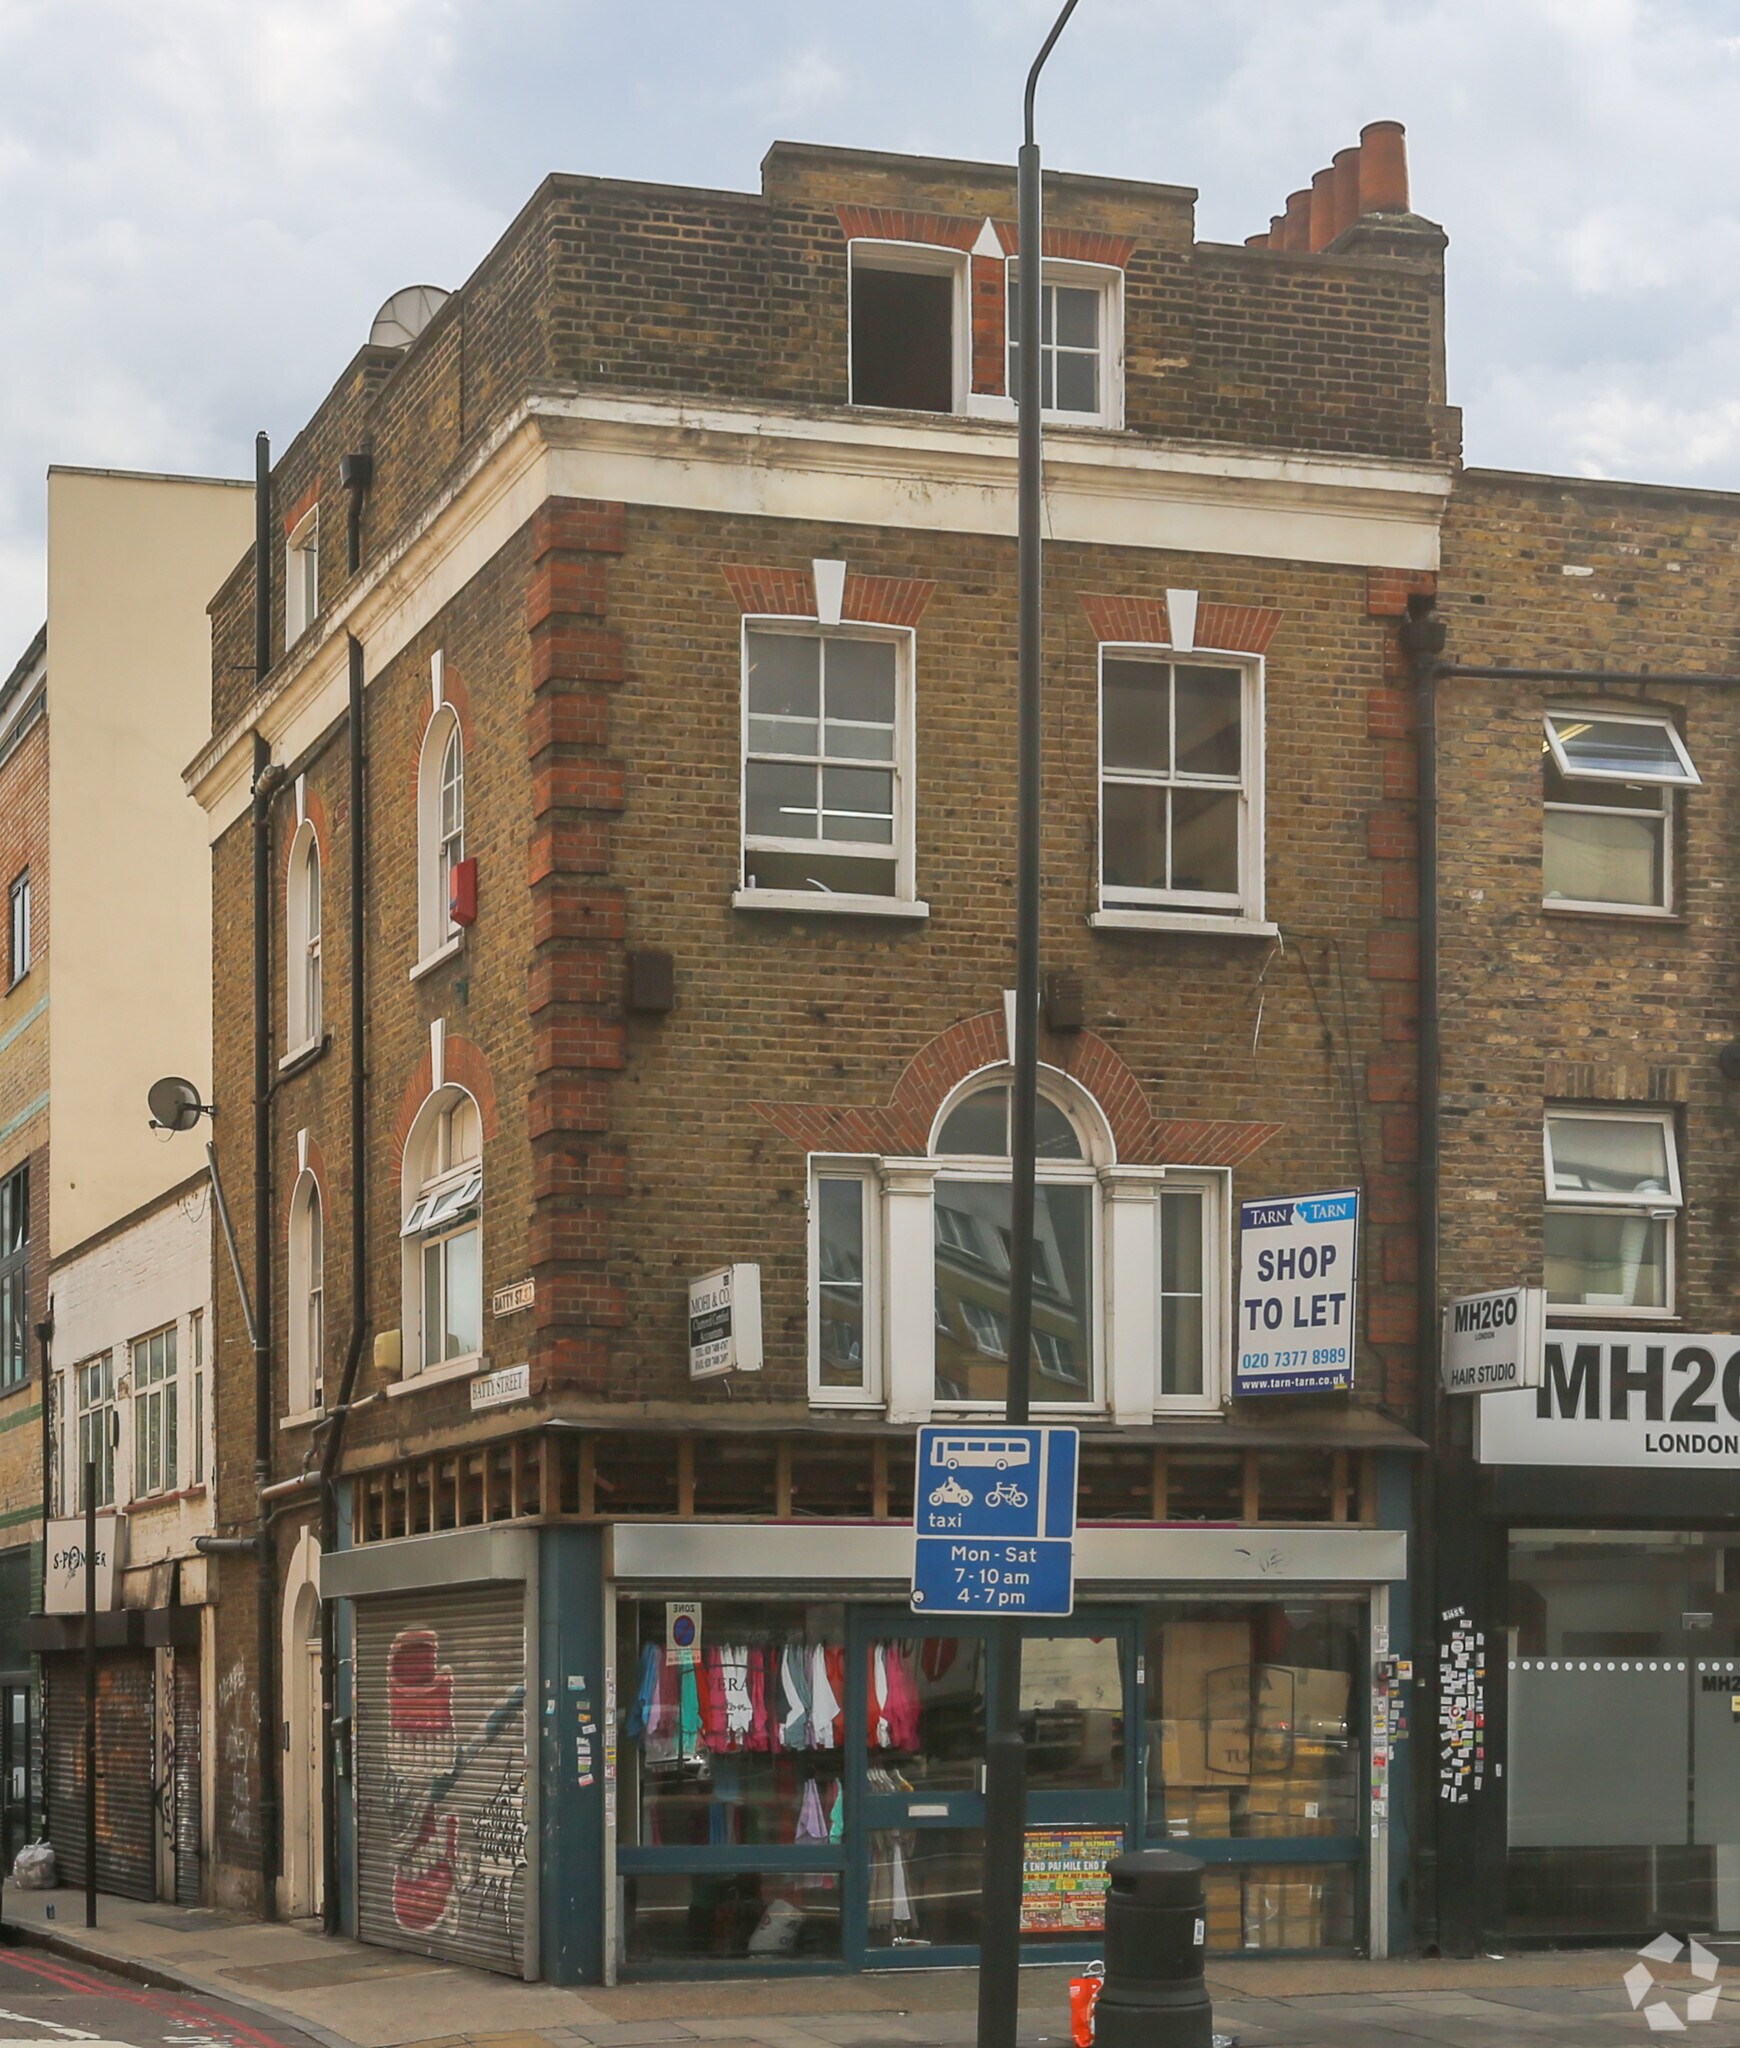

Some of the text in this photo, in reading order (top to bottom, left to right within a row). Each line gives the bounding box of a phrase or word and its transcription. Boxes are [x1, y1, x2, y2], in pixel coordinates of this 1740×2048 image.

[1251, 1209, 1287, 1225] TARN
[1310, 1202, 1347, 1219] TARN
[1257, 1245, 1337, 1282] SHOP
[494, 1292, 514, 1312] BATTY
[712, 1291, 718, 1308] &
[1244, 1292, 1347, 1330] TO LET
[1455, 1297, 1518, 1333] MH2GO
[1475, 1331, 1495, 1341] LONDON
[1242, 1347, 1346, 1368] 020 7377 8989
[1242, 1373, 1346, 1390] www.tarn-tarn.co.uk
[1451, 1362, 1516, 1387] HAIR STUDIO
[1536, 1342, 1740, 1424] MH2
[472, 1379, 495, 1401] BATTY
[497, 1371, 523, 1394] STREET
[1645, 1433, 1738, 1454] LONDON
[928, 1513, 962, 1528] taxi
[951, 1546, 990, 1561] Mon
[1005, 1547, 1038, 1563] Sat
[1003, 1573, 1030, 1585] am
[998, 1593, 1025, 1606] pm
[1030, 1861, 1045, 1871] END
[1063, 1861, 1081, 1871] MILE
[1084, 1861, 1099, 1871] END
